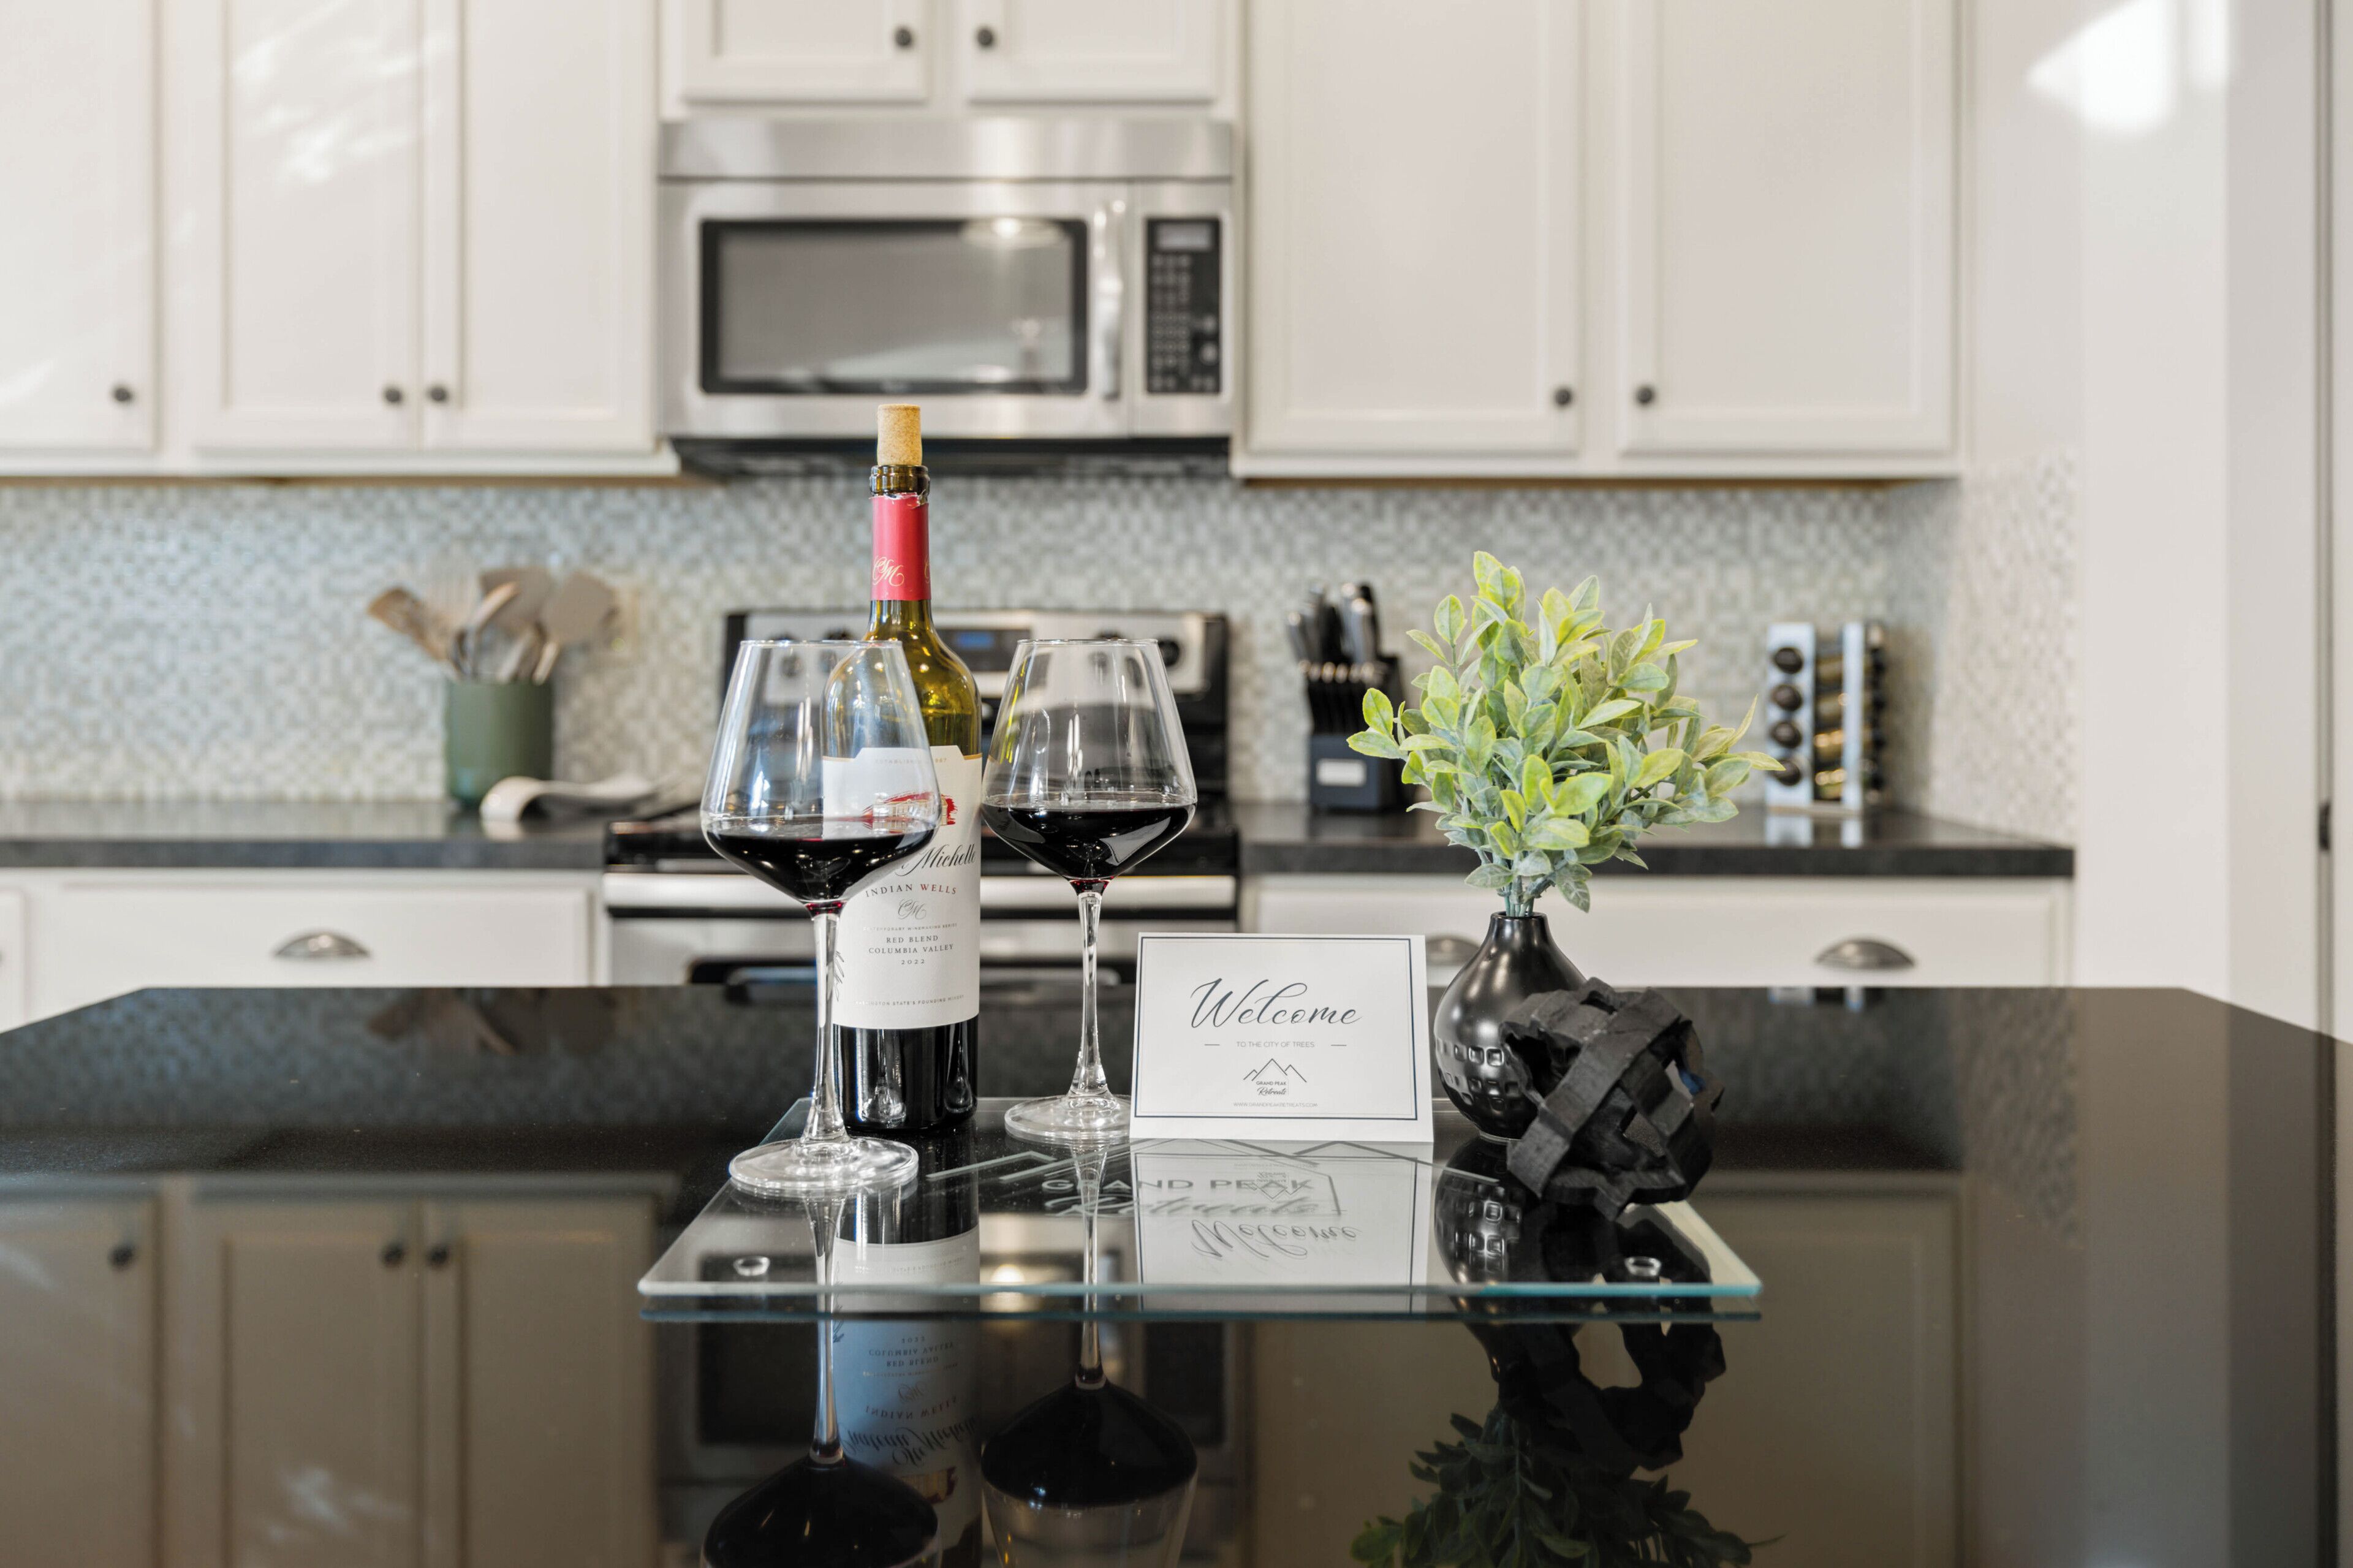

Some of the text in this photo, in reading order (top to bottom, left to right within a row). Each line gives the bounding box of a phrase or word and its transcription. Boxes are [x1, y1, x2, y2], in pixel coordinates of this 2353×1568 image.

[865, 883, 957, 898] INDIAN WELLS
[923, 944, 954, 953] VALLEY
[1190, 978, 1362, 1028] Welcome
[1257, 1086, 1287, 1096] Retreats
[1210, 1180, 1315, 1189] PEAK
